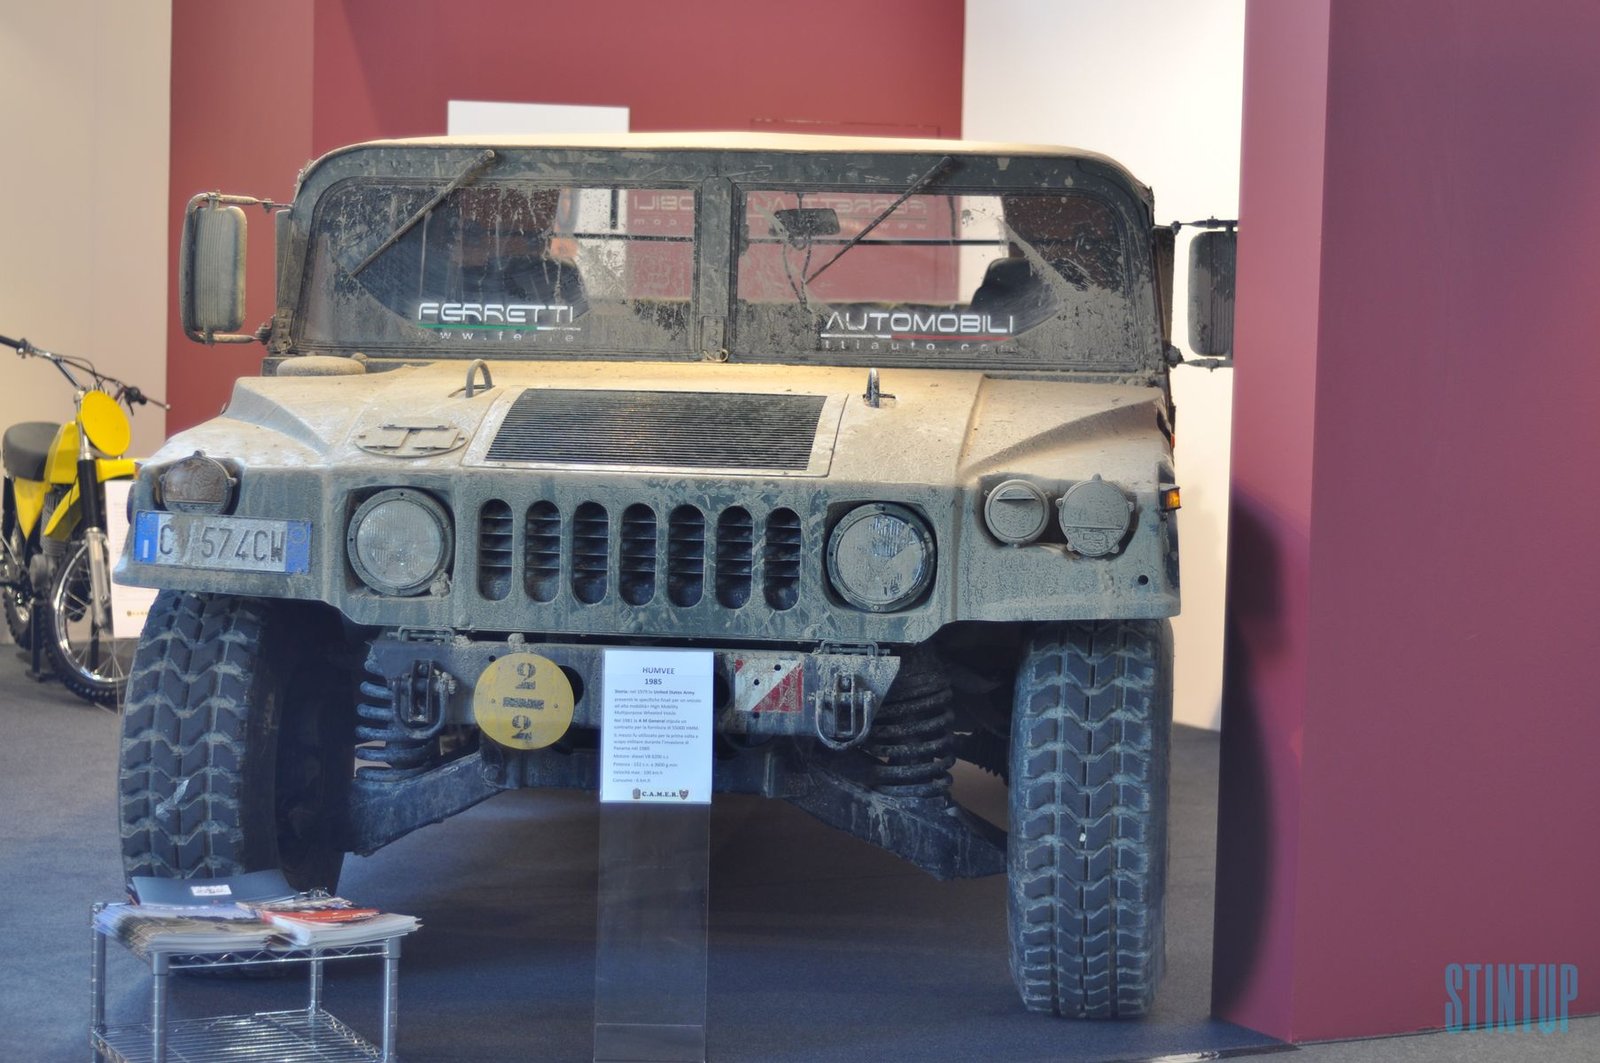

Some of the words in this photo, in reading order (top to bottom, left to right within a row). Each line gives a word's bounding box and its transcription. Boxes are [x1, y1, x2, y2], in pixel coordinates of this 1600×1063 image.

[418, 302, 574, 323] FERRETTI
[826, 312, 1014, 334] AUTOMOBILI
[642, 667, 676, 675] HUMVEE
